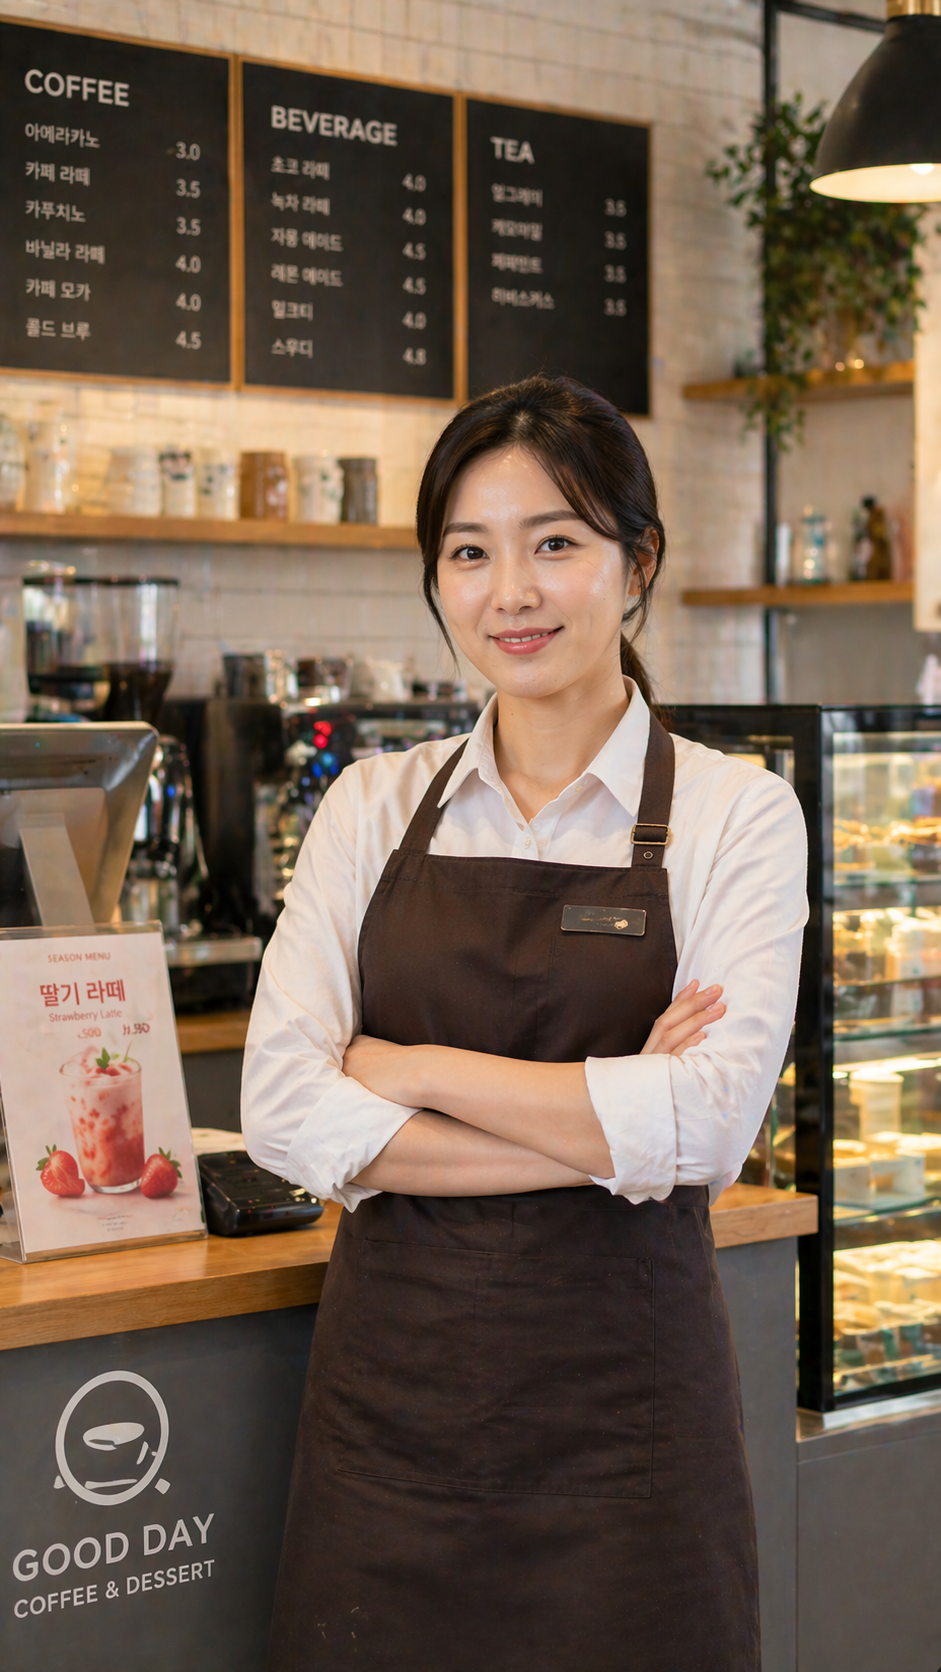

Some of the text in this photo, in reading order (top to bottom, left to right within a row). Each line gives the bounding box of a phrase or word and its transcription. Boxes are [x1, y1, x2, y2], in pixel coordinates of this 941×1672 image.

[25, 69, 129, 107] COFFEE
[271, 104, 398, 147] BEVERAGE
[176, 142, 200, 160] 3.0
[490, 136, 535, 164] TEA
[26, 162, 200, 198] 카페 라떼 3.5
[26, 200, 201, 236] 카푸치노 3.5
[26, 239, 71, 260] 바닐라
[176, 255, 201, 273] 4.0
[26, 279, 201, 311] 카페 모카 4.0
[176, 331, 201, 349] 4.5
[48, 952, 110, 963] SEASON MENU
[40, 979, 125, 1007] 딸기 라떼
[49, 1009, 122, 1022] Strawberry Latte
[13, 1513, 214, 1583] GOOD DAY
[14, 1560, 214, 1618] COFFEE & DESSERT
